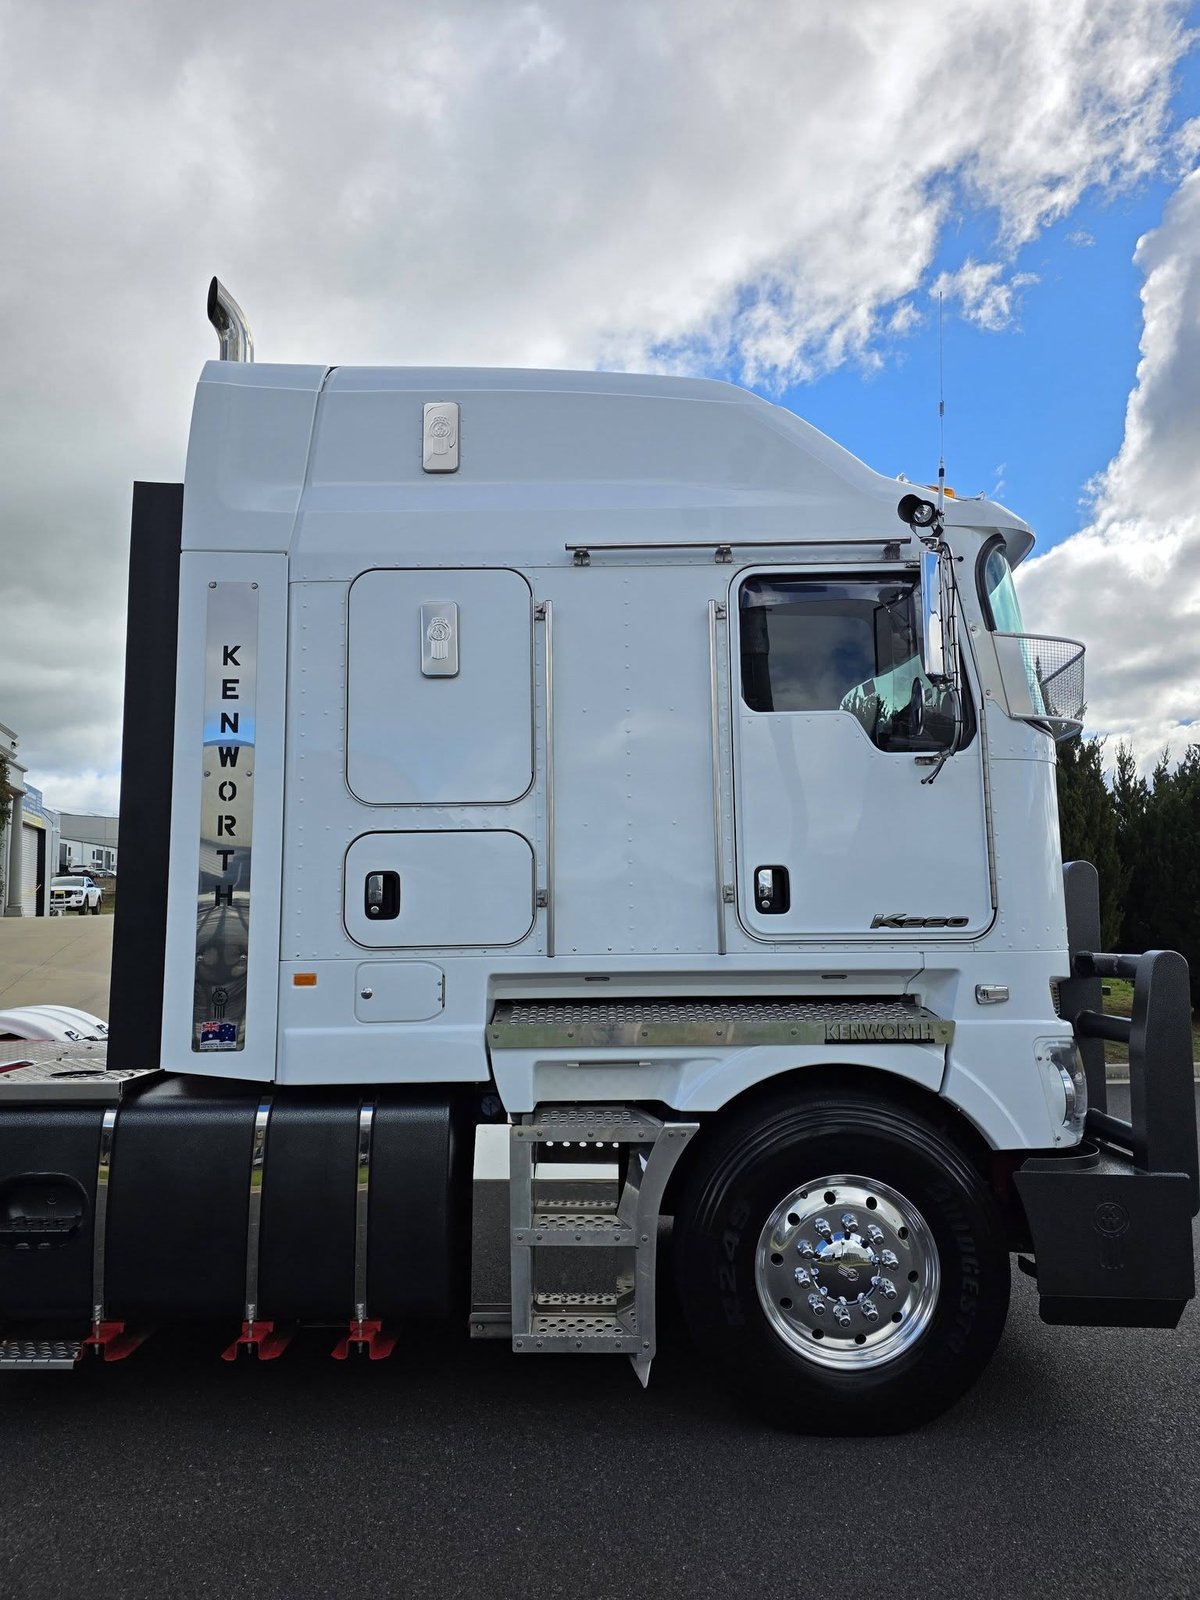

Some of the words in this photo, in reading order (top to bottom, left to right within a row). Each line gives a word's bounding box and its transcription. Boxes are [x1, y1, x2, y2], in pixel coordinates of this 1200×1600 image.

[214, 645, 241, 907] KENWORTH
[869, 913, 969, 929] K220
[824, 1022, 935, 1040] KENWORTH
